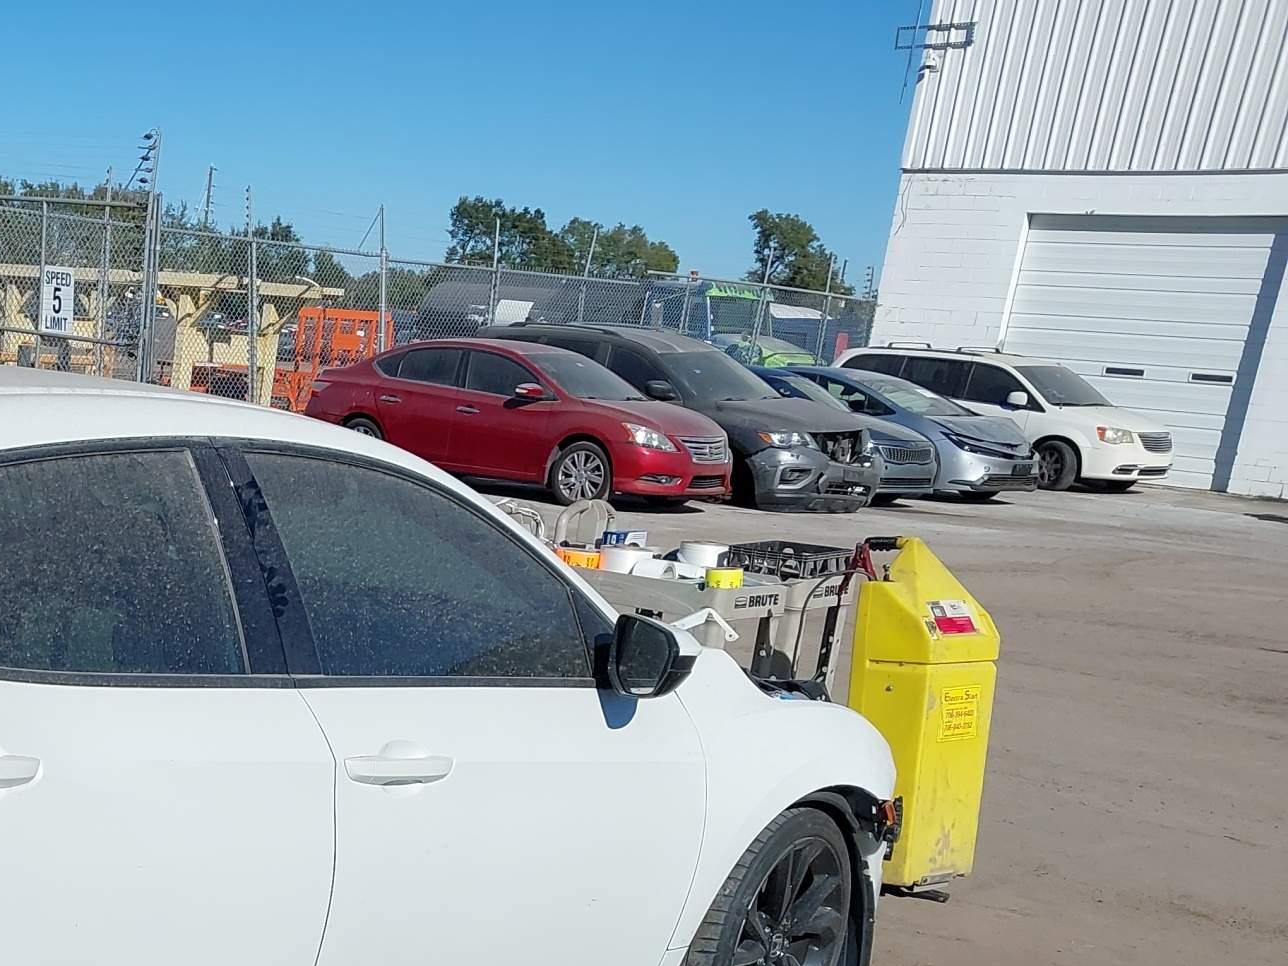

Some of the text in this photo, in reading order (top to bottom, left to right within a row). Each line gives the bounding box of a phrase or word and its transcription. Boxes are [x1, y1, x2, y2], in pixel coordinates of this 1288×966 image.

[45, 270, 72, 287] SPEED
[52, 286, 62, 314] 5
[44, 315, 68, 332] LIMIT
[824, 585, 849, 598] BRUE
[748, 593, 779, 608] BRUTE
